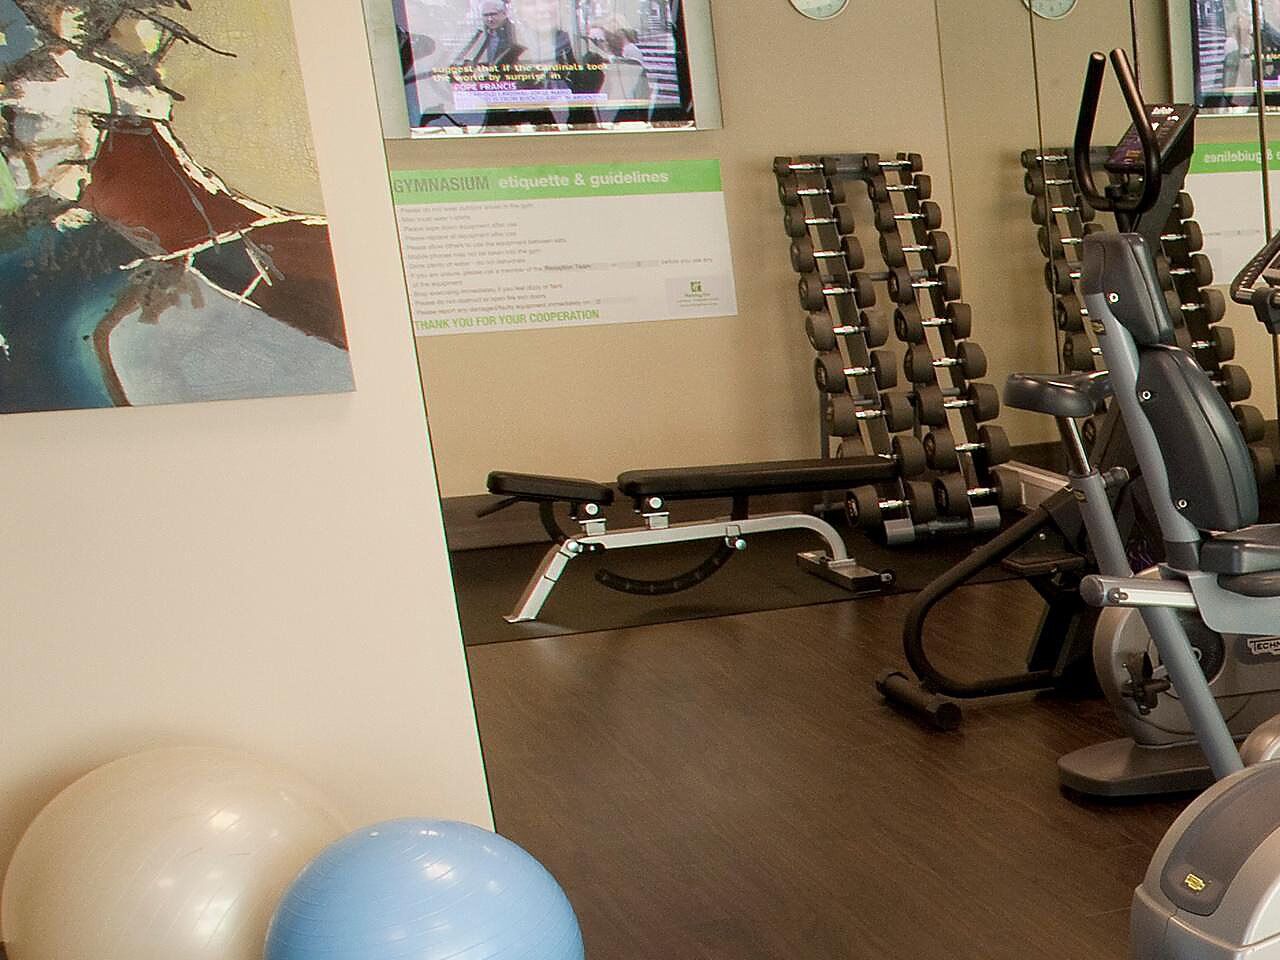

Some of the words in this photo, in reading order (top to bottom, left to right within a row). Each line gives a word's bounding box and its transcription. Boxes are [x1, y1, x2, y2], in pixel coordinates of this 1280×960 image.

[393, 175, 490, 193] GYMNASIUM
[499, 174, 569, 190] etiquette
[575, 172, 586, 186] &
[590, 170, 670, 188] guidelines
[415, 318, 450, 330] THANK
[452, 317, 475, 328] YOU
[476, 315, 497, 327] FOR
[499, 312, 526, 325] YOUR
[529, 309, 600, 323] COOPERATION
